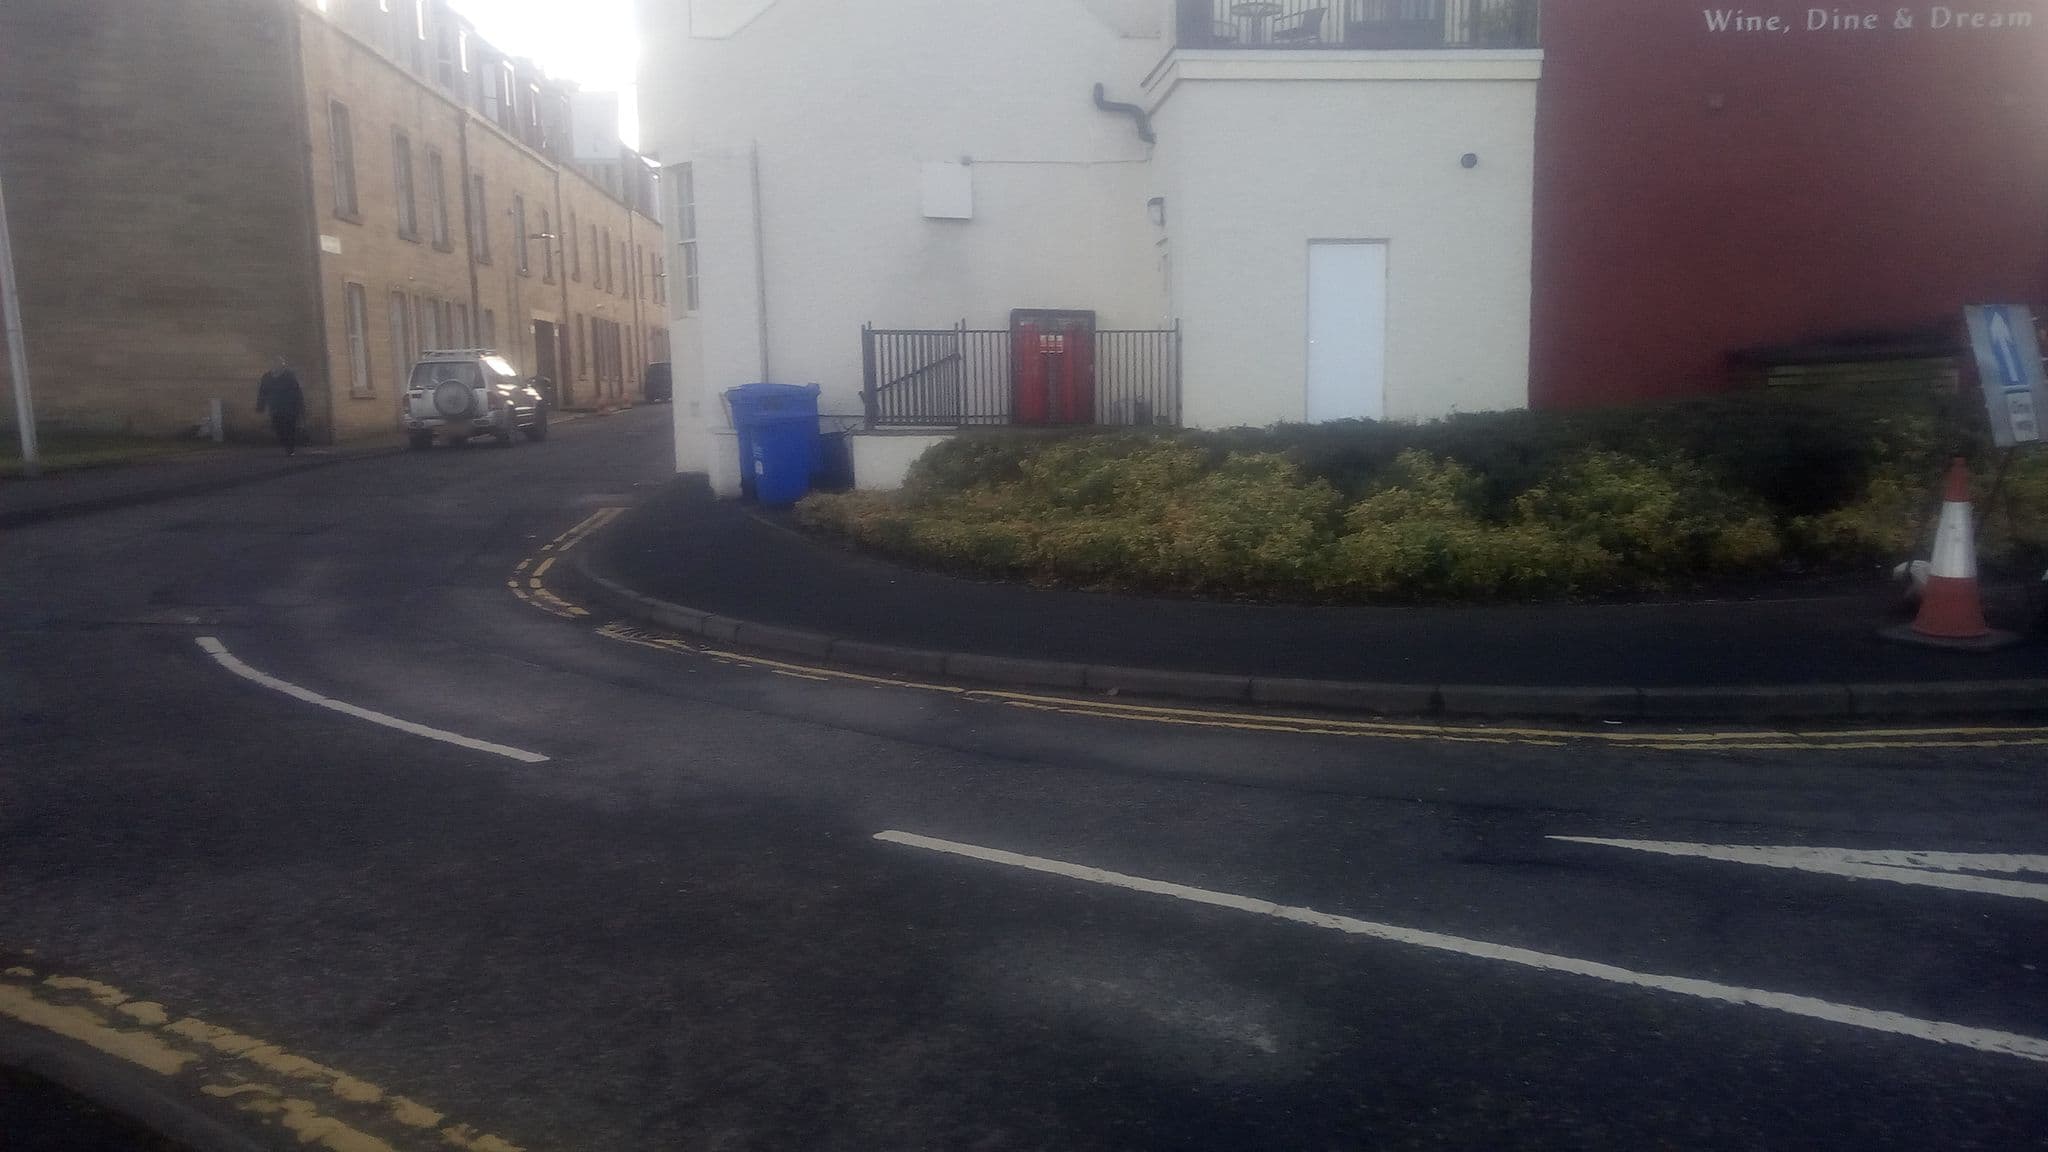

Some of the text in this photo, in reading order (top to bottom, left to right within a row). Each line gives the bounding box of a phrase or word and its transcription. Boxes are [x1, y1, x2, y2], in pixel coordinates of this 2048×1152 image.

[1703, 6, 2033, 34] Wine, Dine & Dream
